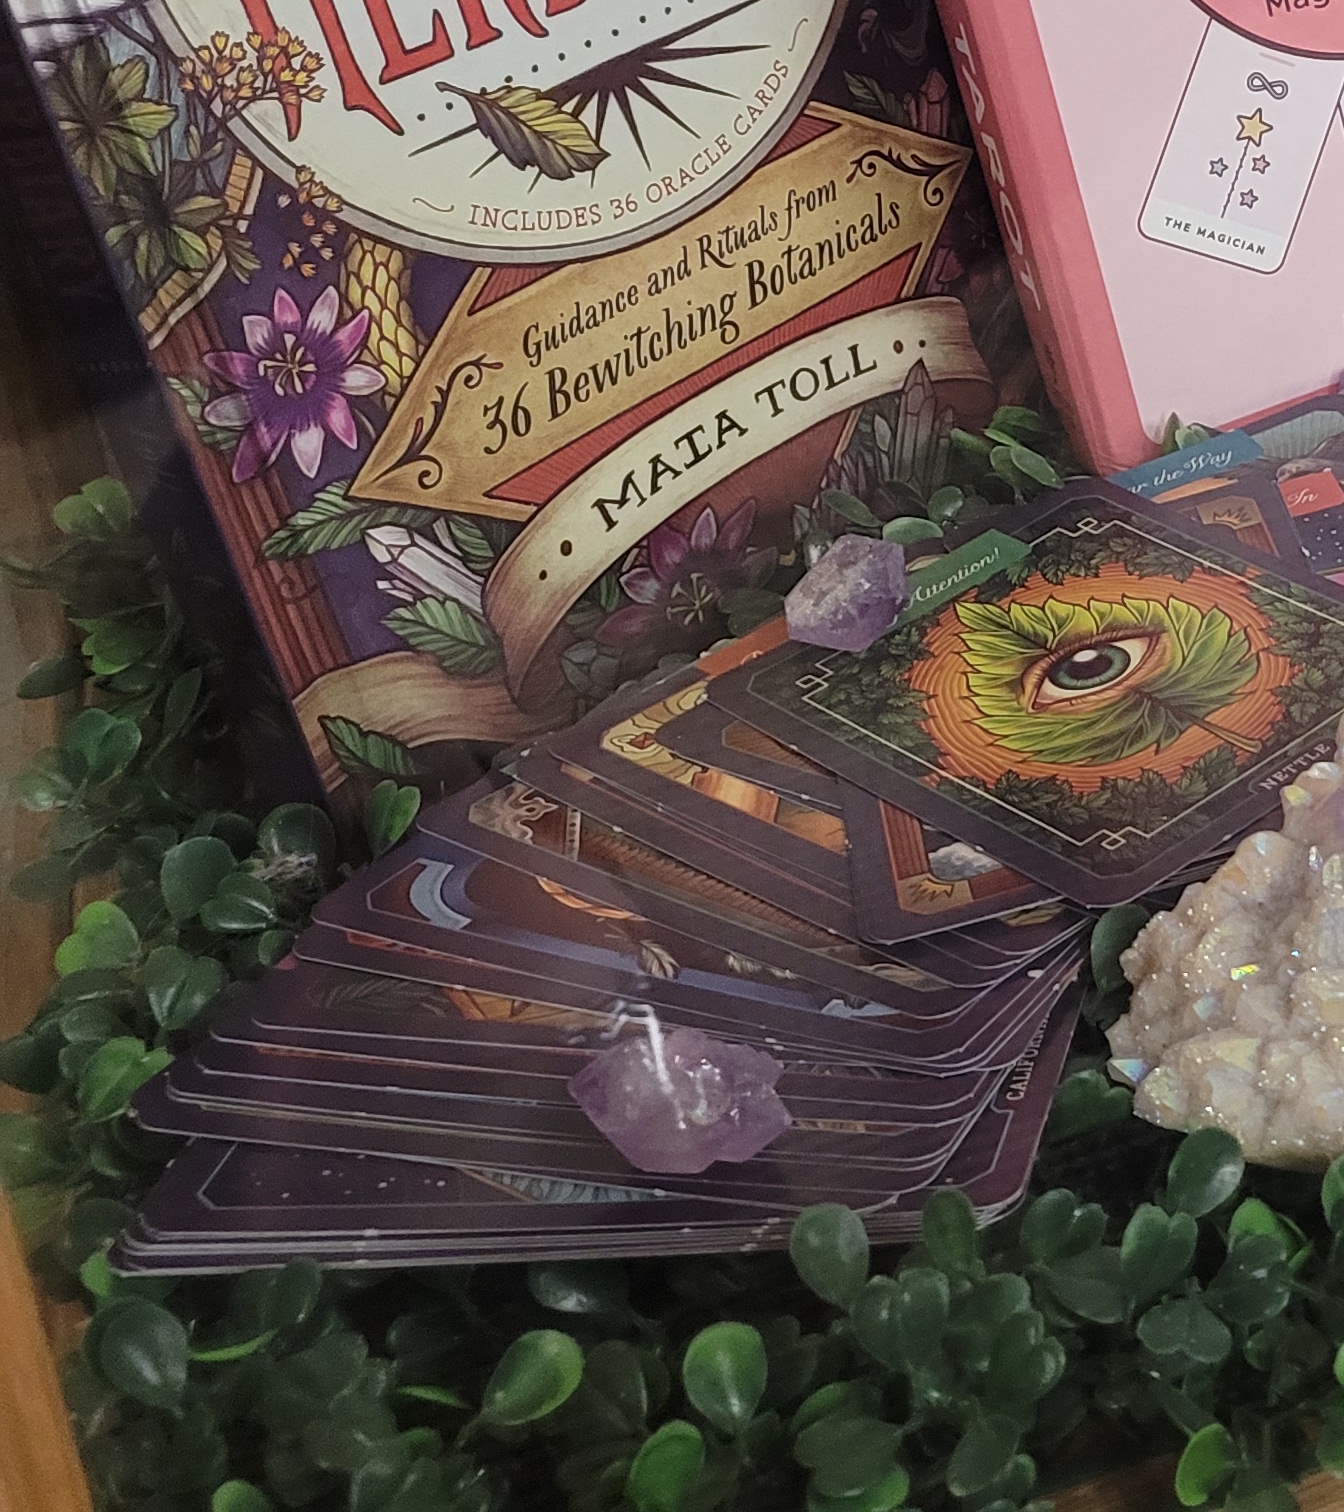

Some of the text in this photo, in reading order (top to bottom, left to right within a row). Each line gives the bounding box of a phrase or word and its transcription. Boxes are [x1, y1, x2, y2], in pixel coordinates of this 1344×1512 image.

[469, 60, 790, 232] INCLUDES 36 ORACLE CARDS
[951, 22, 1040, 312] TAROT
[522, 178, 839, 367] Guidance and Rituals from
[1165, 216, 1266, 255] THE MAGICIAN
[480, 192, 902, 455] 36 Bewitching Botanicals
[591, 342, 877, 533] MAIA TOLL
[1154, 449, 1232, 486] the Way
[896, 546, 1001, 618] Attention!
[1259, 743, 1331, 790] NETTLE
